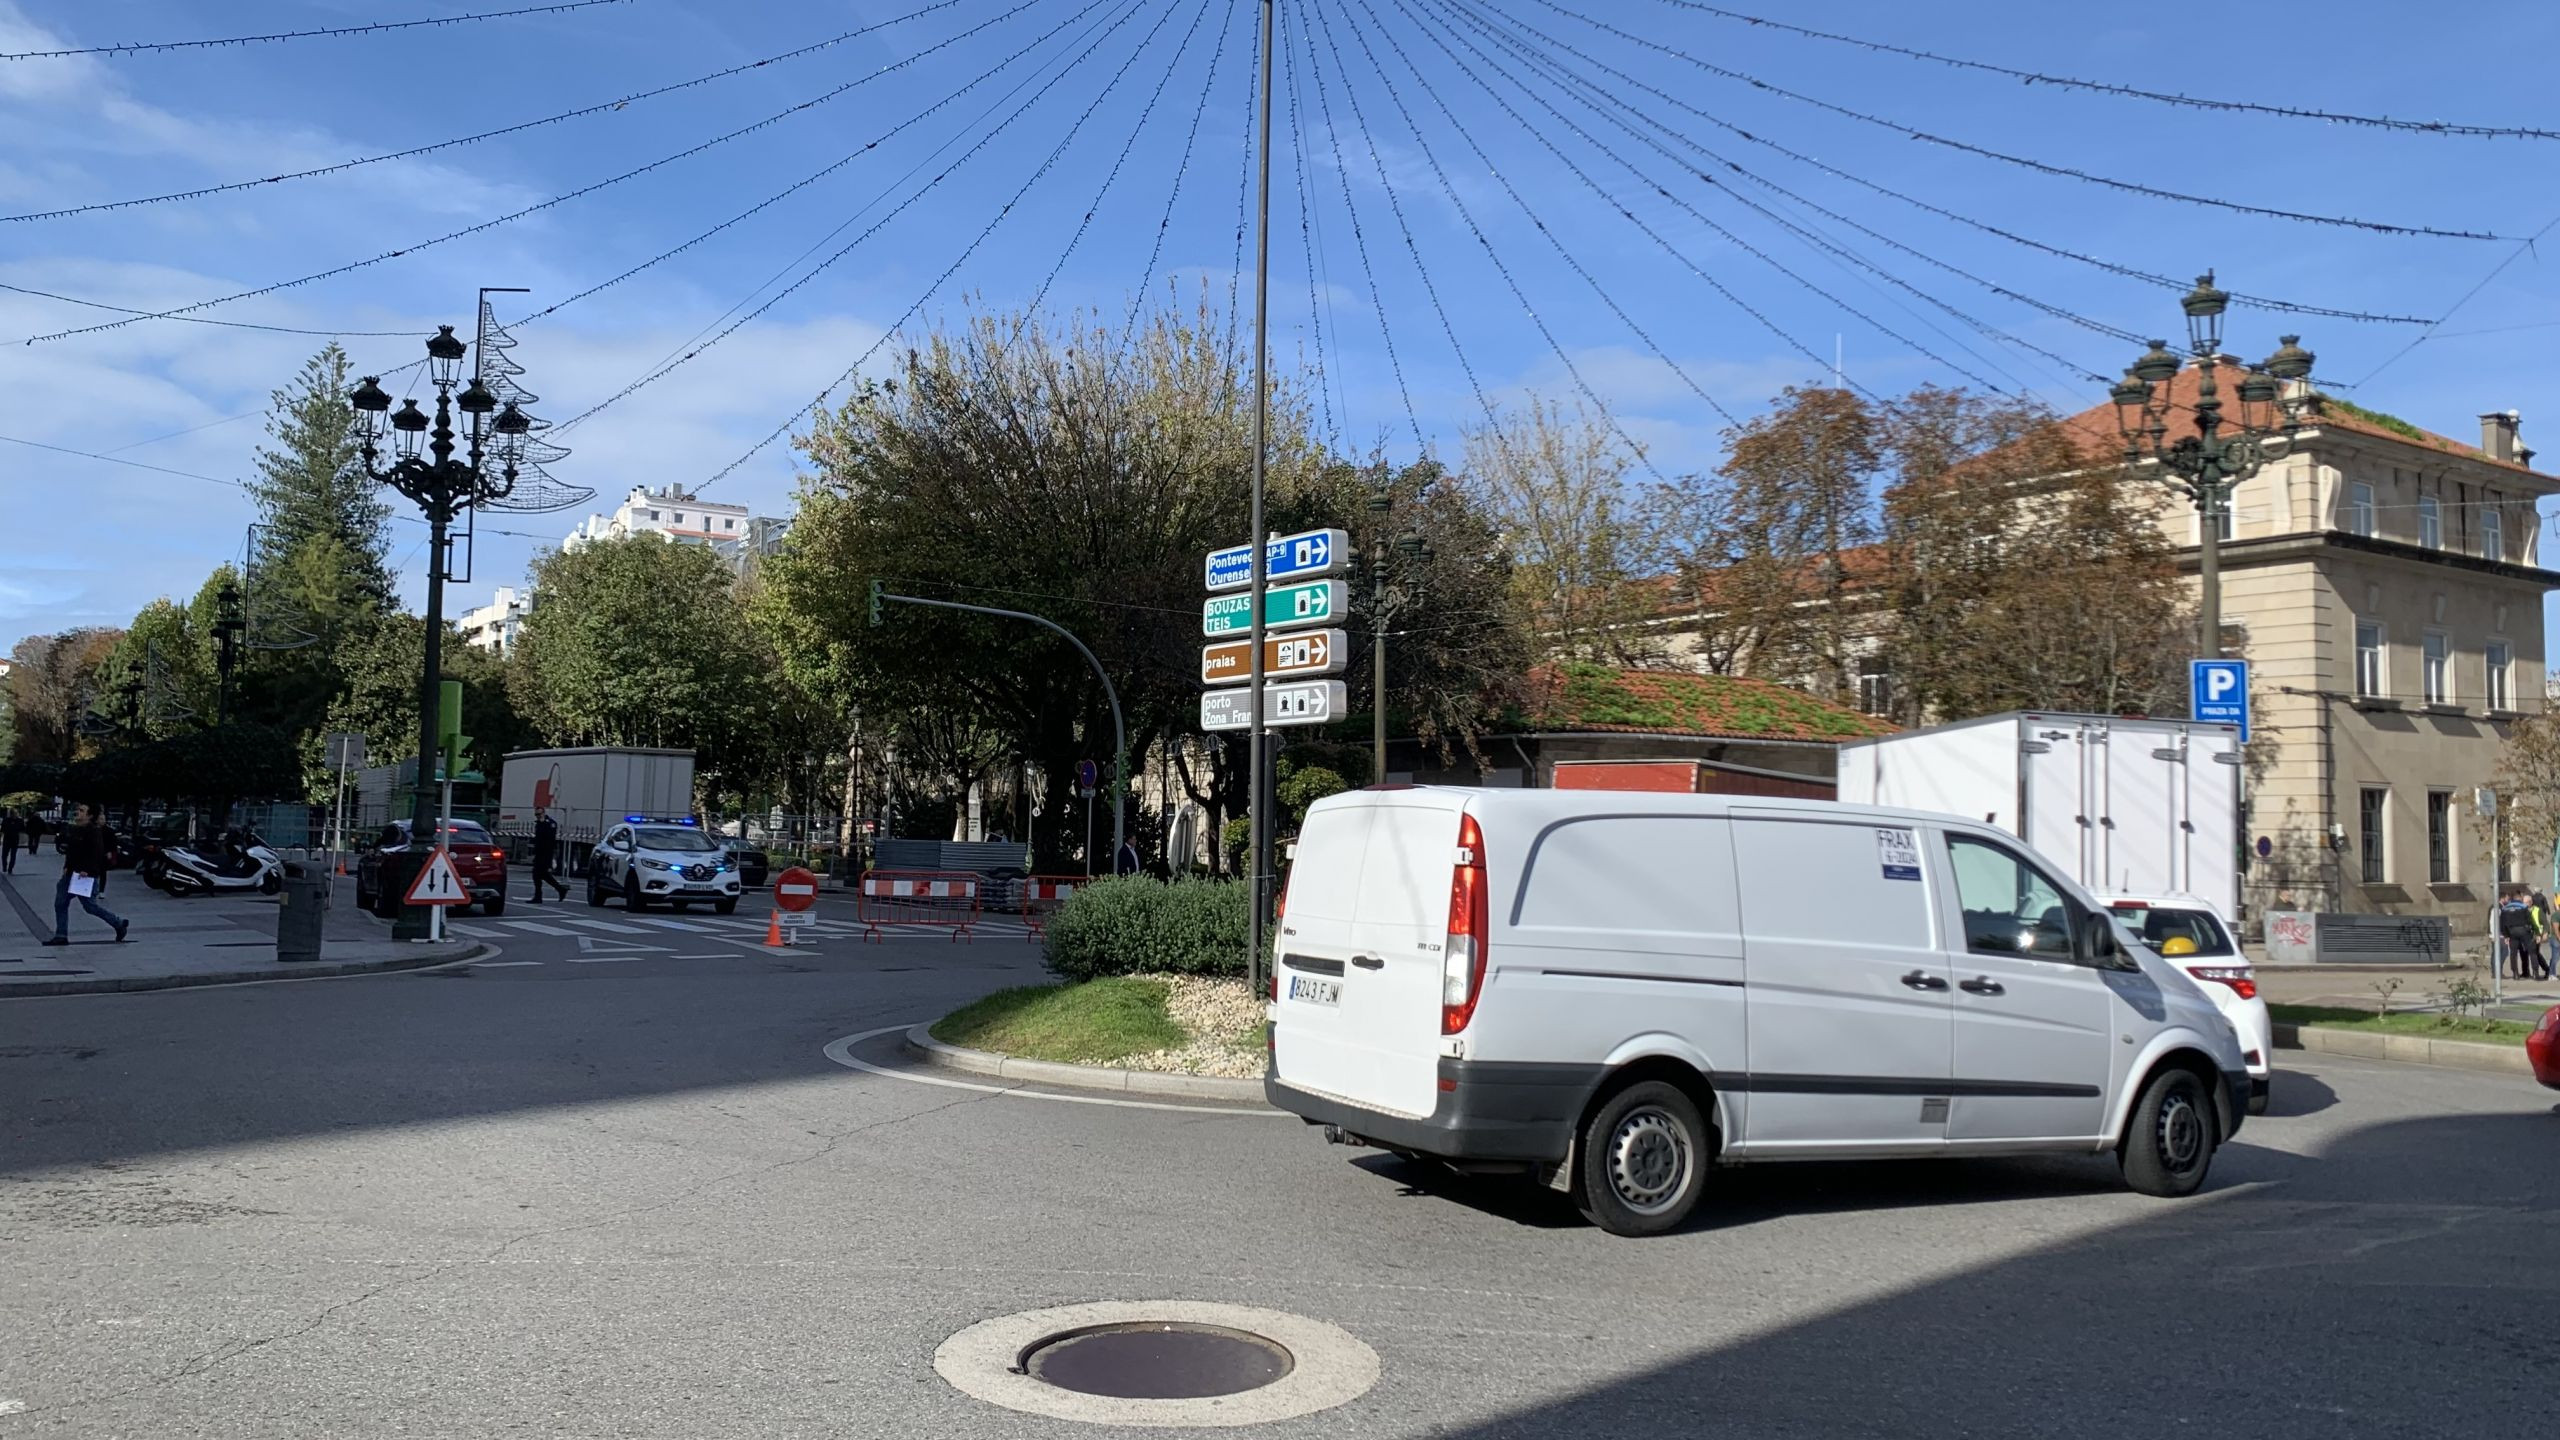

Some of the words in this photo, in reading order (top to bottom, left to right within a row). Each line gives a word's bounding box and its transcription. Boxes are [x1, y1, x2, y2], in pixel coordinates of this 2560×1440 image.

[1266, 544, 1286, 558] AP-9
[1209, 569, 1251, 584] Ourense
[1207, 598, 1250, 616] BOUZAS
[1207, 617, 1230, 632] TEIS
[1206, 655, 1236, 673] praias
[2208, 669, 2235, 701] P
[1205, 696, 1231, 712] porto
[1205, 712, 1226, 725] Zona
[1232, 709, 1252, 723] Fran
[1283, 927, 1296, 936] Vito
[1295, 979, 1317, 999] 8243
